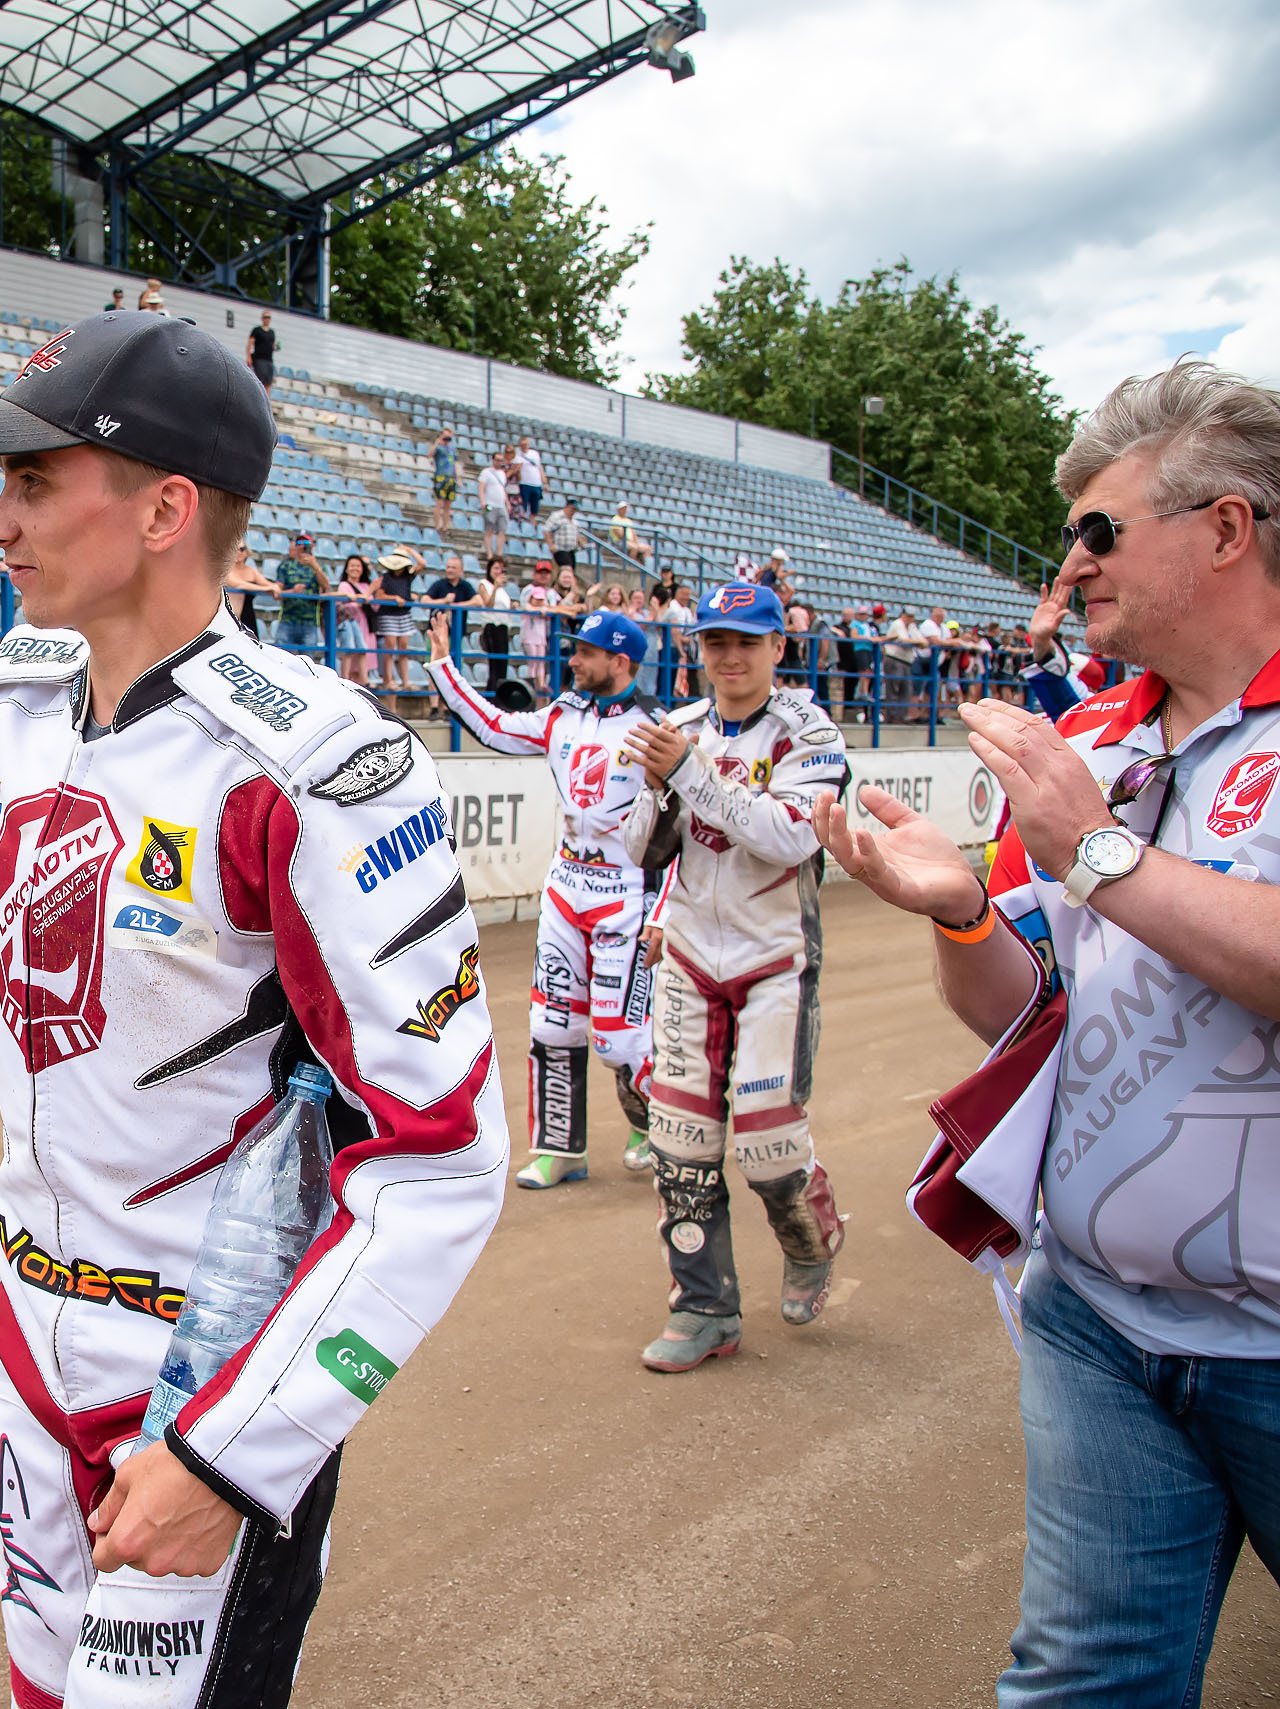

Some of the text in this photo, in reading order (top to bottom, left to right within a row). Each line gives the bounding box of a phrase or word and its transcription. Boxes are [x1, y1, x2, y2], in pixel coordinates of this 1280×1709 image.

[209, 654, 307, 722] GORINA
[1220, 760, 1276, 802] LOKOMOTIV
[450, 793, 524, 848] IBET
[32, 861, 98, 921] DAUGAVPILS
[144, 873, 175, 889] PZM
[582, 879, 628, 894] North
[32, 880, 96, 938] SPEEDWAY CLUB
[129, 910, 163, 932] 2LŻ
[545, 963, 570, 1029] LIFTS
[544, 1046, 572, 1151] MERIDIAN
[736, 1075, 786, 1096] eWinner
[86, 1652, 180, 1676] FAMILY
